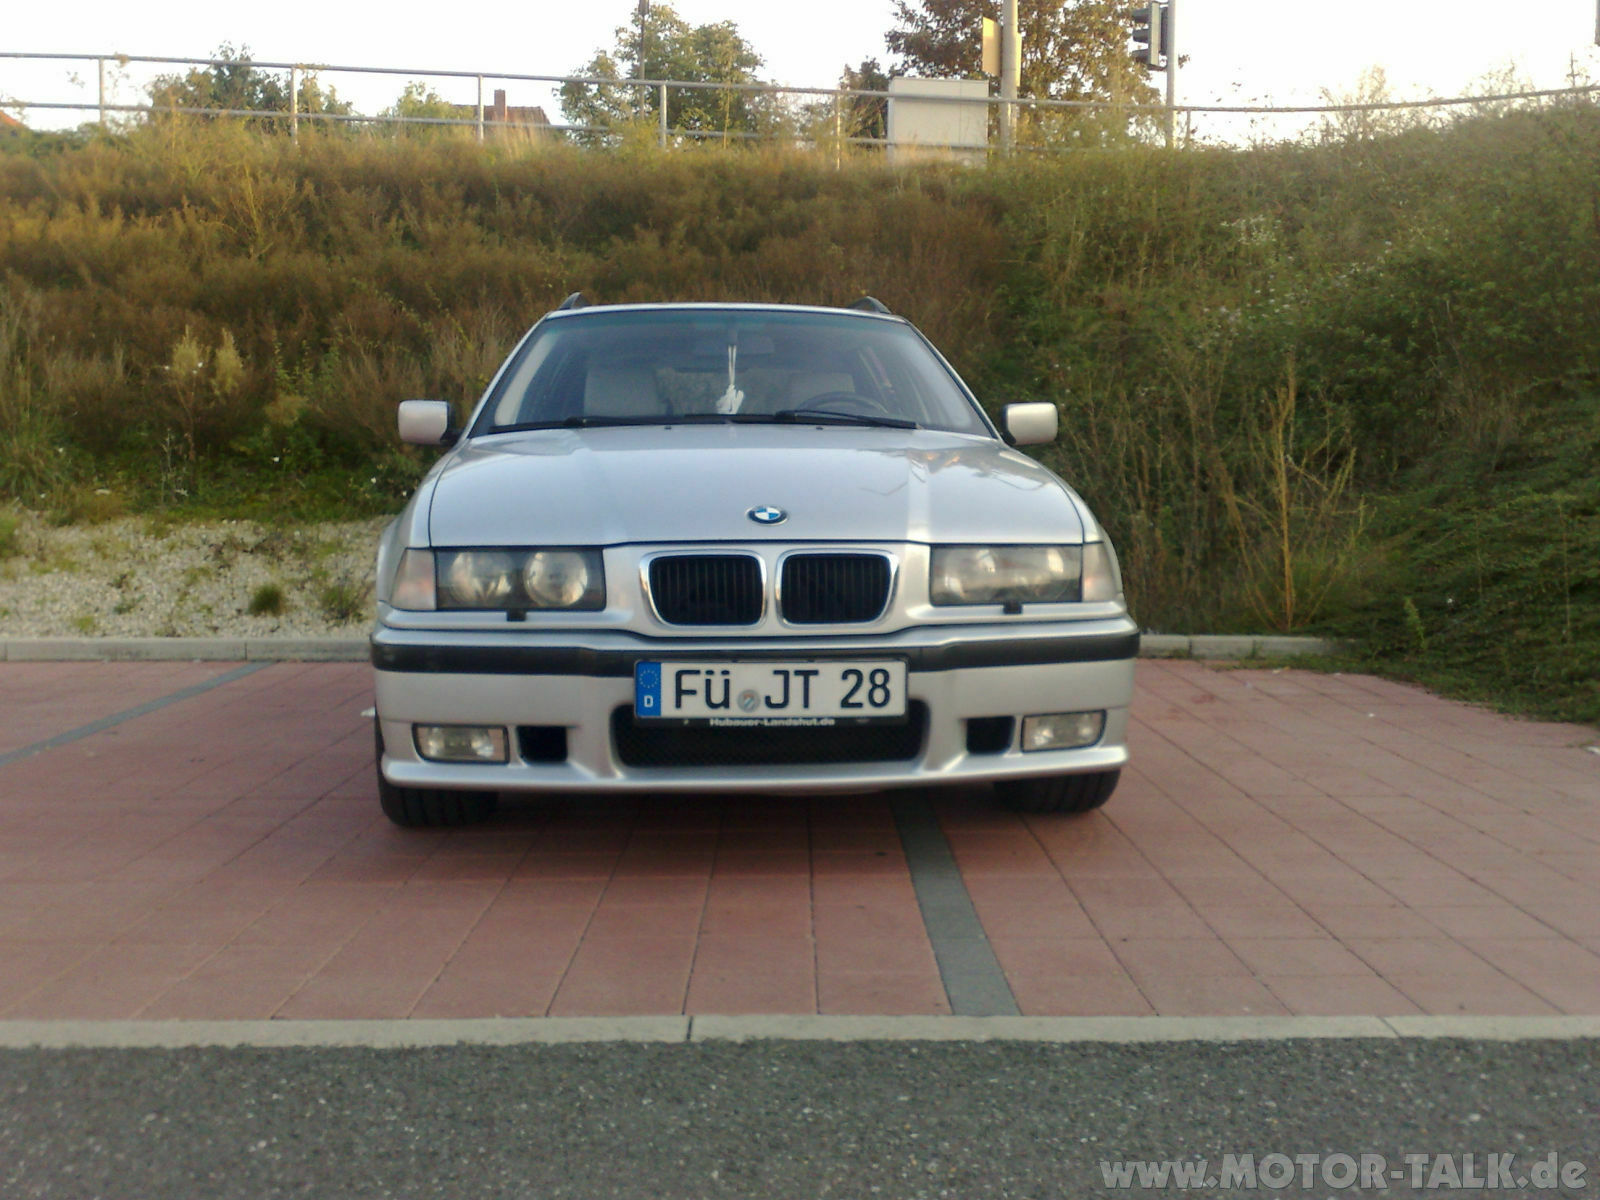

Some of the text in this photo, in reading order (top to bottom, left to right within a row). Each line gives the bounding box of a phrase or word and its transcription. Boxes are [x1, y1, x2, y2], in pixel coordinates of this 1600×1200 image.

[643, 694, 654, 708] D
[675, 668, 891, 708] FÜ JT 28
